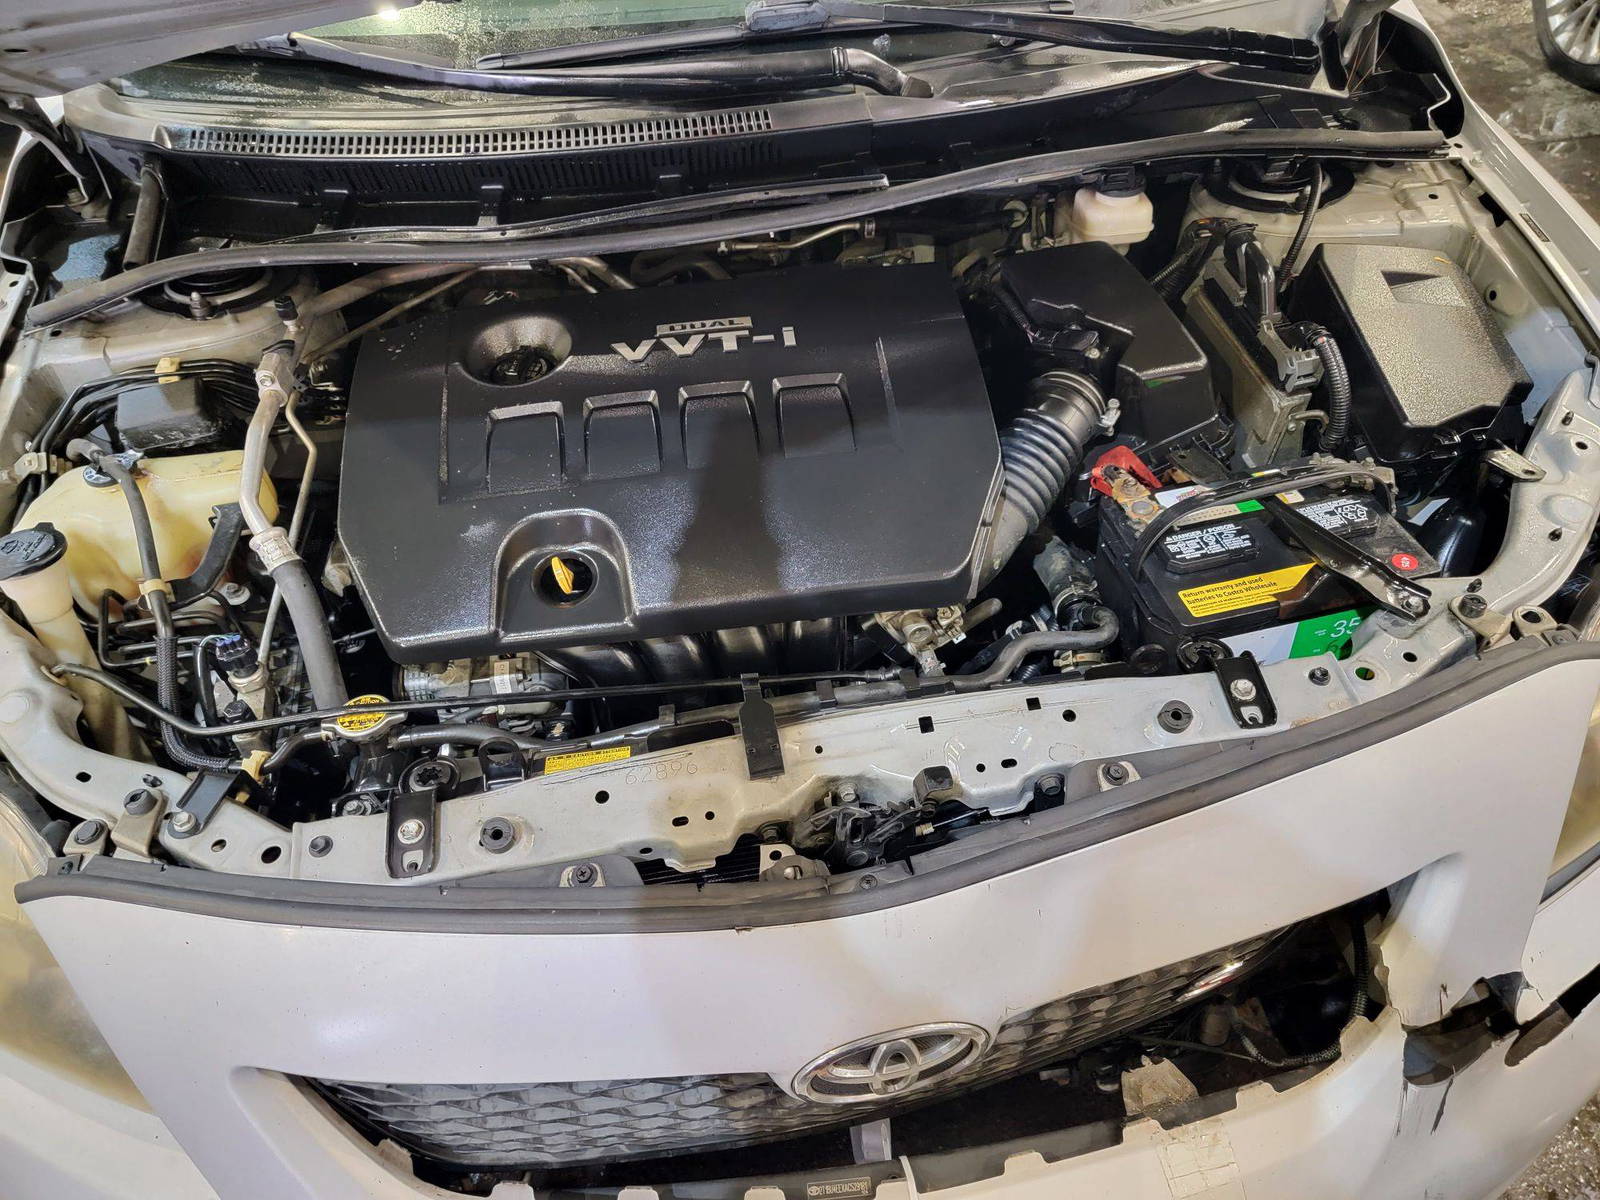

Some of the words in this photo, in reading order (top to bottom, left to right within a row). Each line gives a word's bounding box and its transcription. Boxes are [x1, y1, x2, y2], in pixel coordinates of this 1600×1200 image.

[669, 319, 745, 332] DUAL
[1182, 590, 1205, 598] Return
[1206, 584, 1234, 594] warranty
[1248, 576, 1264, 584] used
[1186, 595, 1215, 605] batteries
[1223, 588, 1244, 597] Costco
[1244, 581, 1278, 592] Wholesale
[625, 760, 698, 785] 62896
